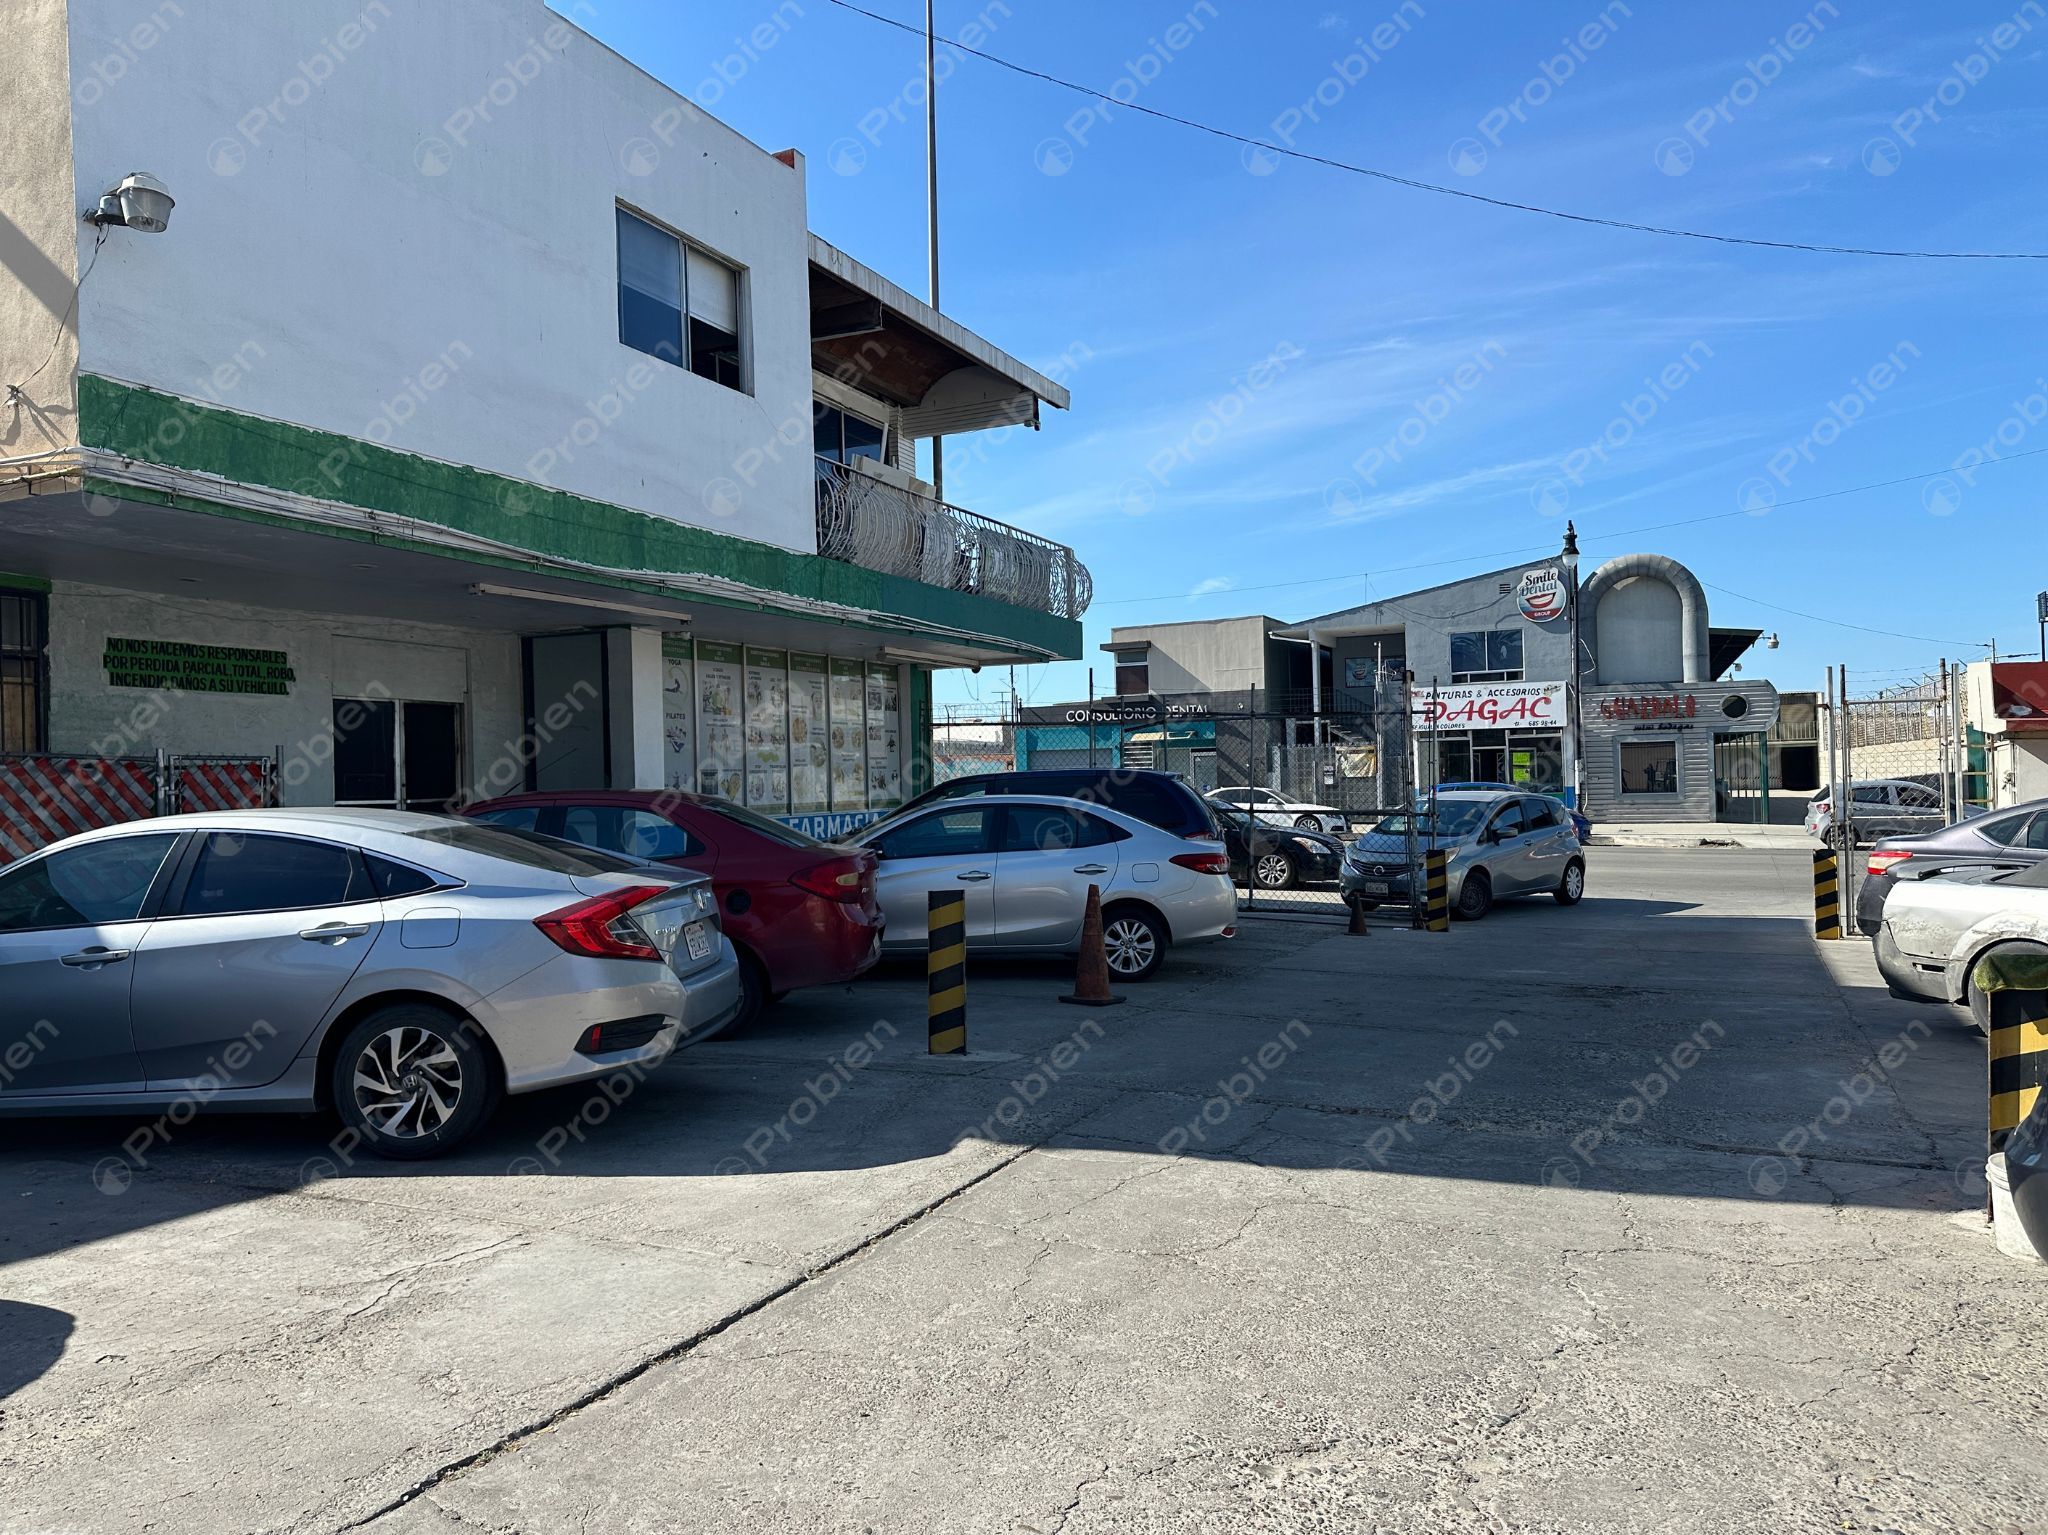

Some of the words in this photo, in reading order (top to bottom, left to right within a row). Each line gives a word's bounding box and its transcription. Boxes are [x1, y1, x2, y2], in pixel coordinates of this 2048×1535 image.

[1525, 571, 1557, 587] Smile
[1519, 580, 1558, 597] Dental
[107, 637, 123, 653] NO
[125, 639, 148, 654] NOS
[151, 640, 206, 659] HACEMOS
[208, 645, 288, 665] RESPONSABLES
[103, 655, 128, 669] POR
[130, 656, 181, 674] PERDIDA
[209, 679, 218, 692] A
[219, 679, 234, 693] SU
[1476, 689, 1483, 698] &
[1487, 687, 1541, 698] ACCESORIOS
[1066, 706, 1157, 722] CONSULTORIO
[1165, 704, 1211, 718] DENTAL
[1422, 697, 1552, 725] DAGAC
